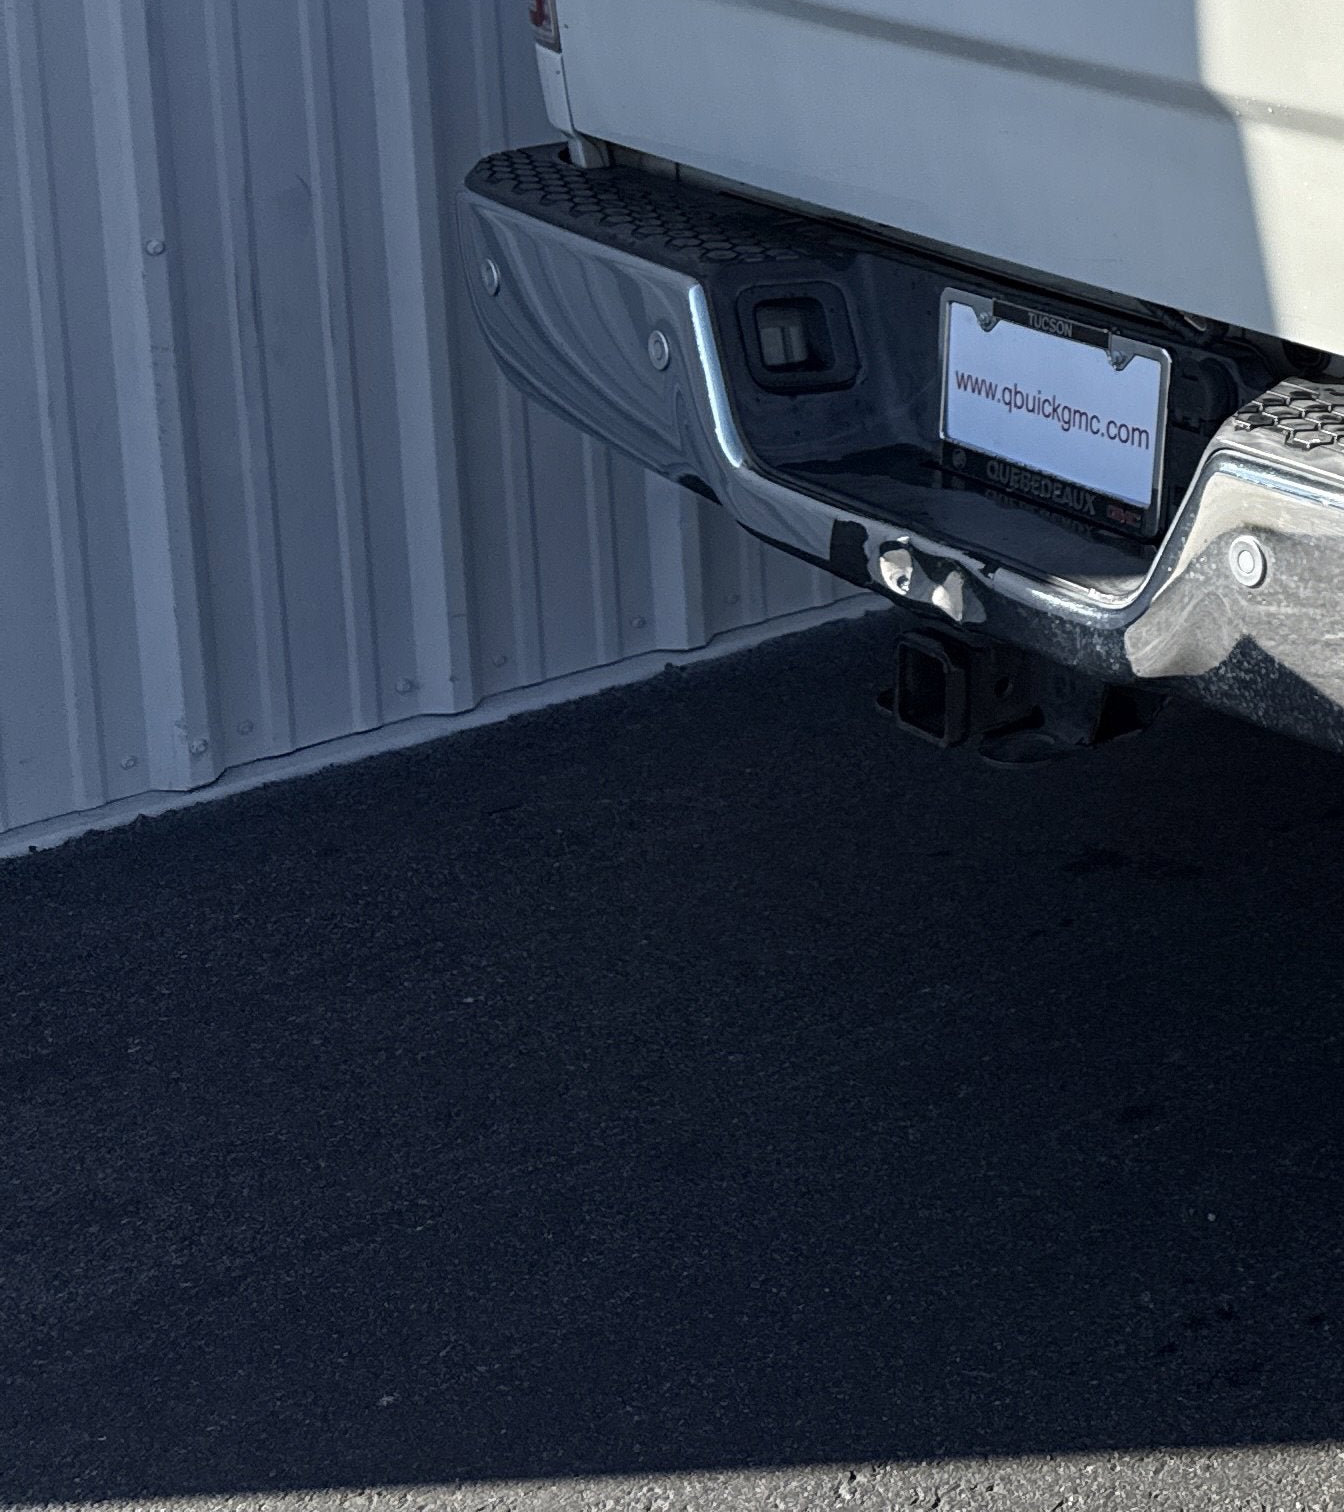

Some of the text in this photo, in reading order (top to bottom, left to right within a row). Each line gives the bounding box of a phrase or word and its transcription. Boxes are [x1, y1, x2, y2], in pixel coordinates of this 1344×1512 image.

[1027, 312, 1073, 338] TUCSON
[955, 370, 1150, 450] www.qbuickgmc.com
[986, 459, 1097, 516] QUEBEDEAUX
